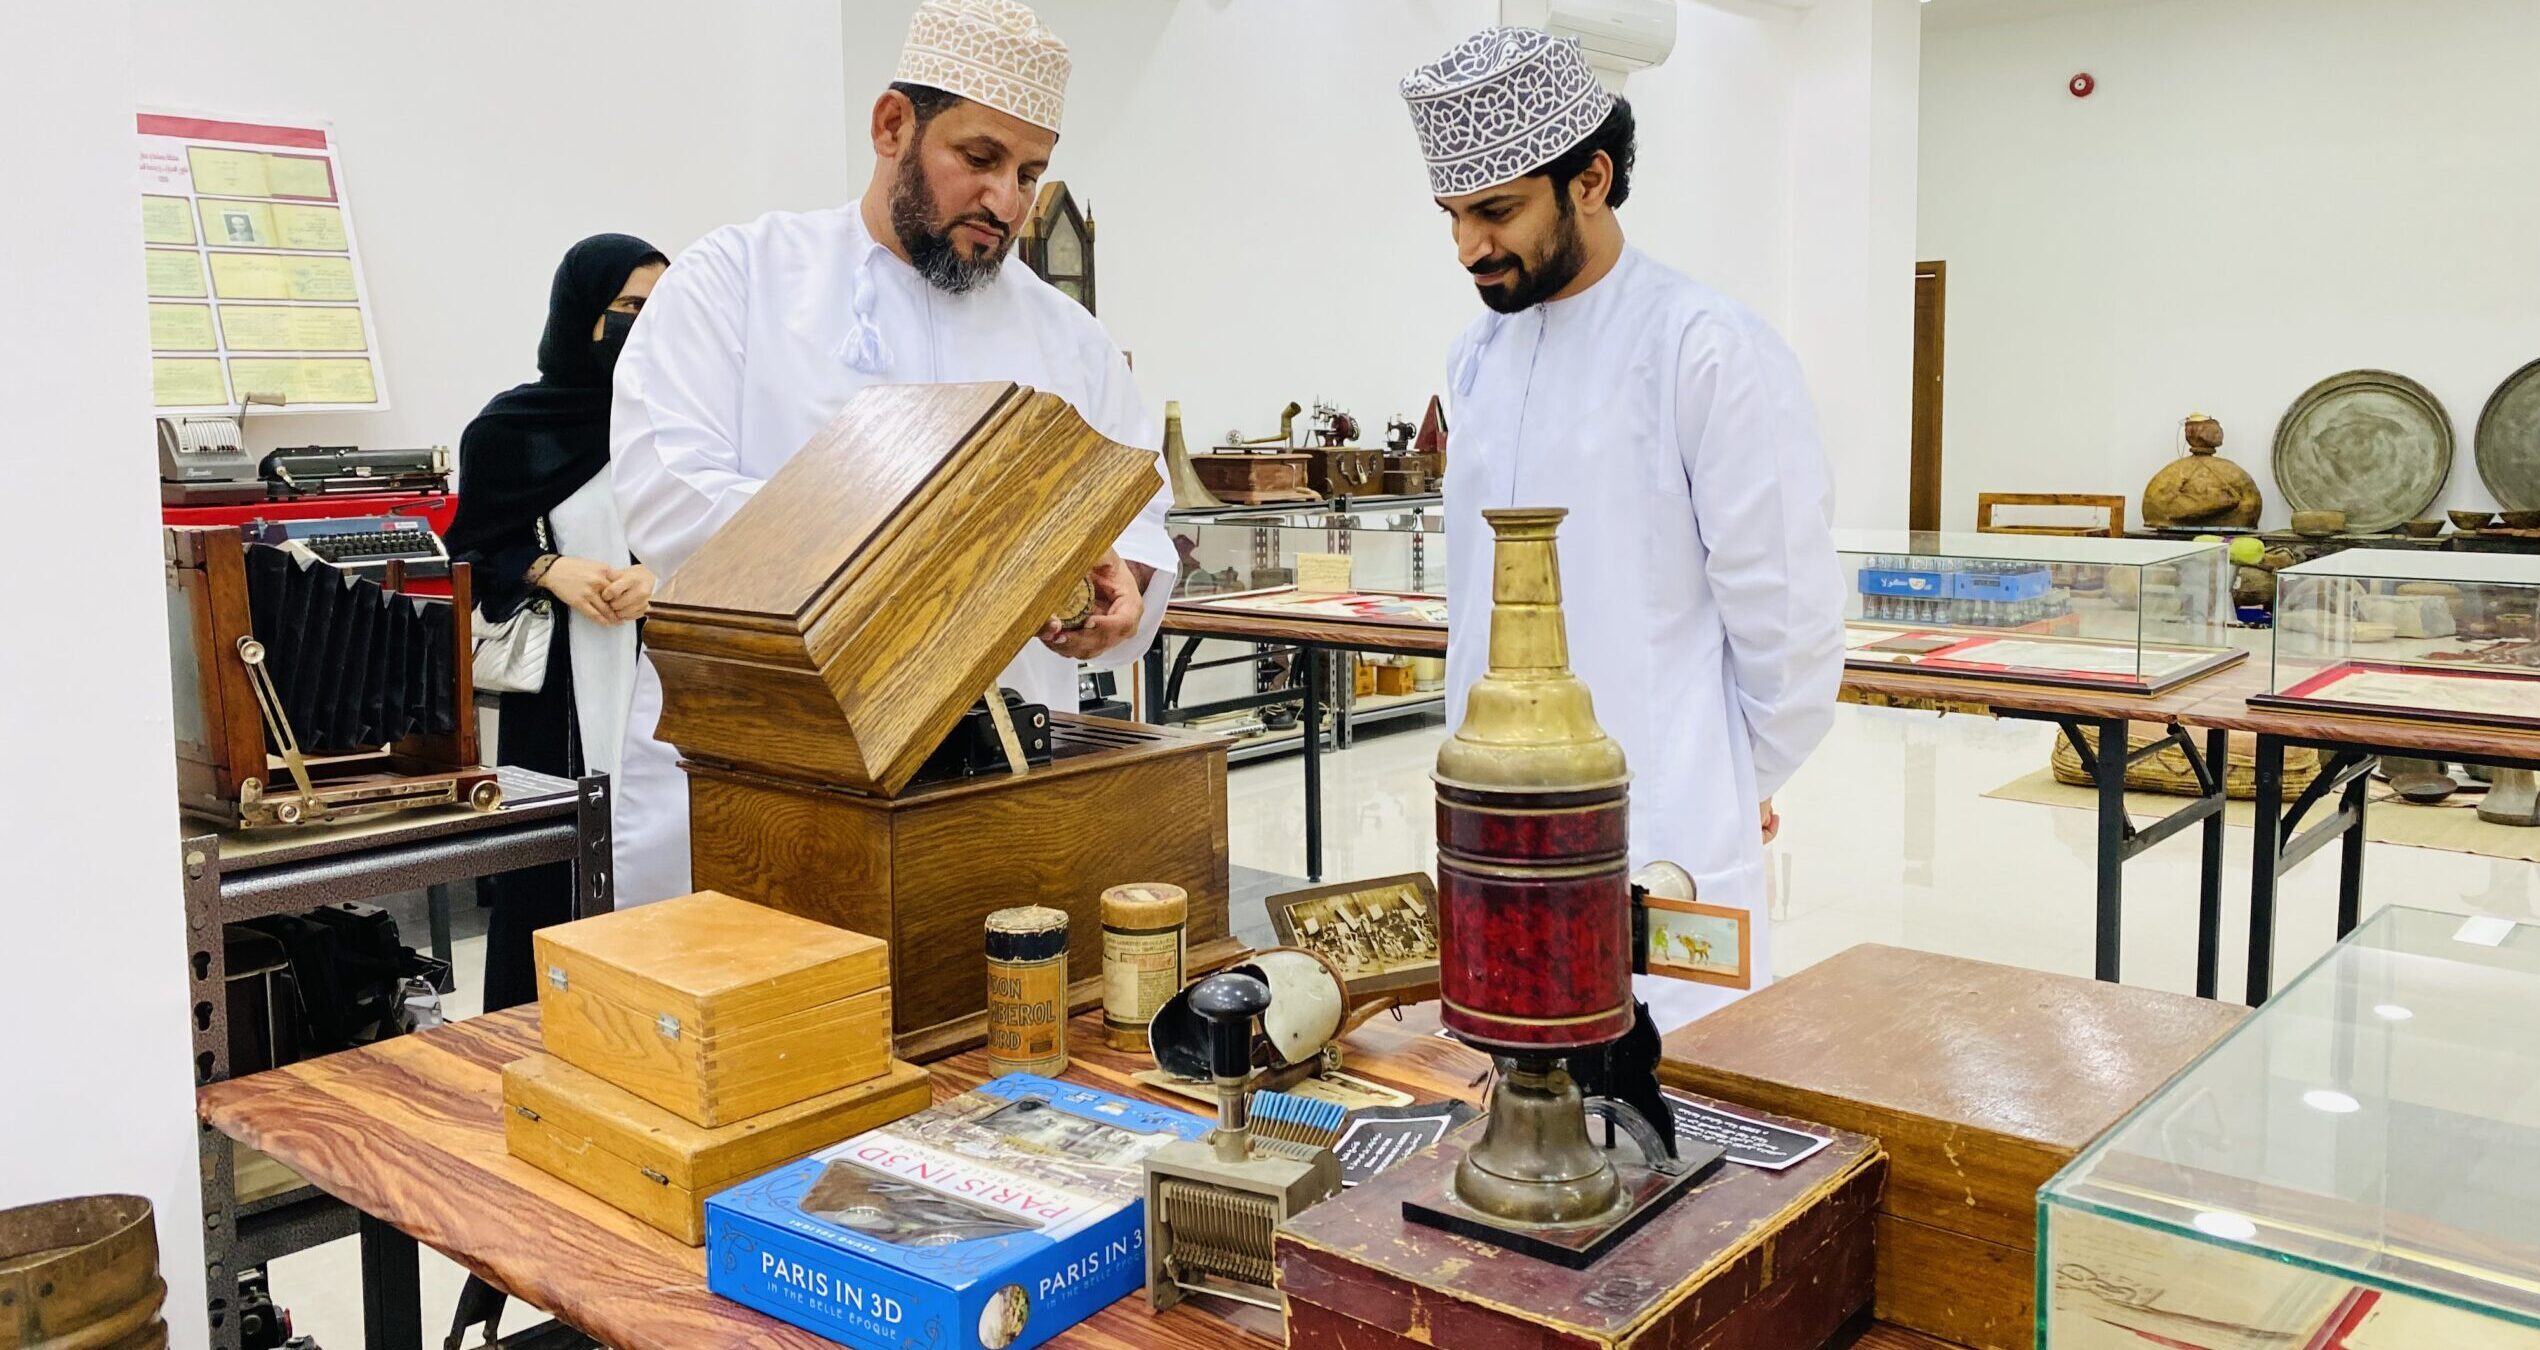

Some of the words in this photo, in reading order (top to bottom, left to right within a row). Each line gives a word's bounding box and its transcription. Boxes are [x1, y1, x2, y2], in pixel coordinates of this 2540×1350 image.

[990, 976, 1021, 999] SON
[857, 1147, 910, 1168] 3D
[904, 1163, 956, 1184] IN
[956, 1178, 1070, 1220] PARIS
[838, 1236, 878, 1254] BRUNO
[1040, 1251, 1099, 1300] PARIS
[1105, 1236, 1127, 1265] IN
[1133, 1229, 1143, 1249] 3
[762, 1251, 829, 1297] PARIS
[836, 1279, 863, 1311] IN
[870, 1293, 903, 1324] 3D
[767, 1281, 778, 1294] IN
[784, 1287, 804, 1305] THE
[809, 1298, 843, 1320] BELLE
